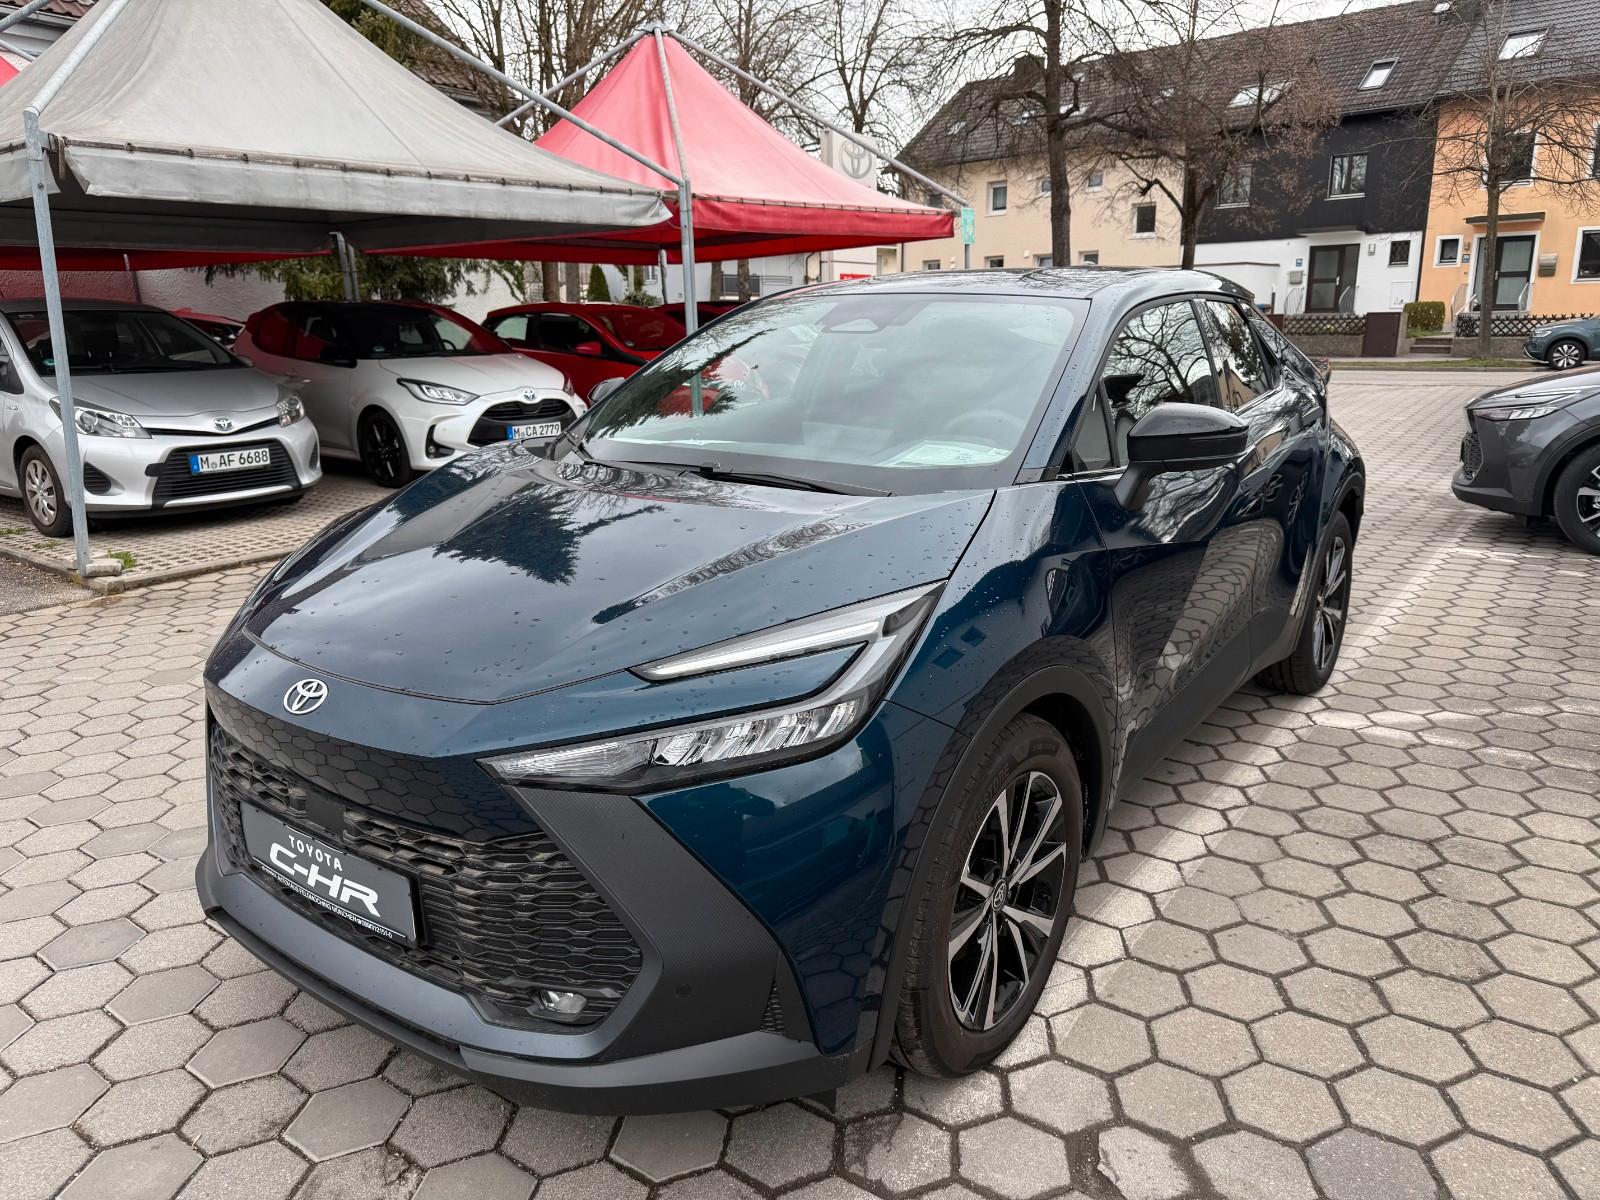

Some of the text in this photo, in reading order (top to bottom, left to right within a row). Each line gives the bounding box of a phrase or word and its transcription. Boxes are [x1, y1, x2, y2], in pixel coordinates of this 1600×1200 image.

[513, 423, 560, 438] M CA 2779
[199, 450, 269, 469] M AF 6688
[288, 834, 343, 872] TOYOTA
[269, 842, 381, 918] C-HR
